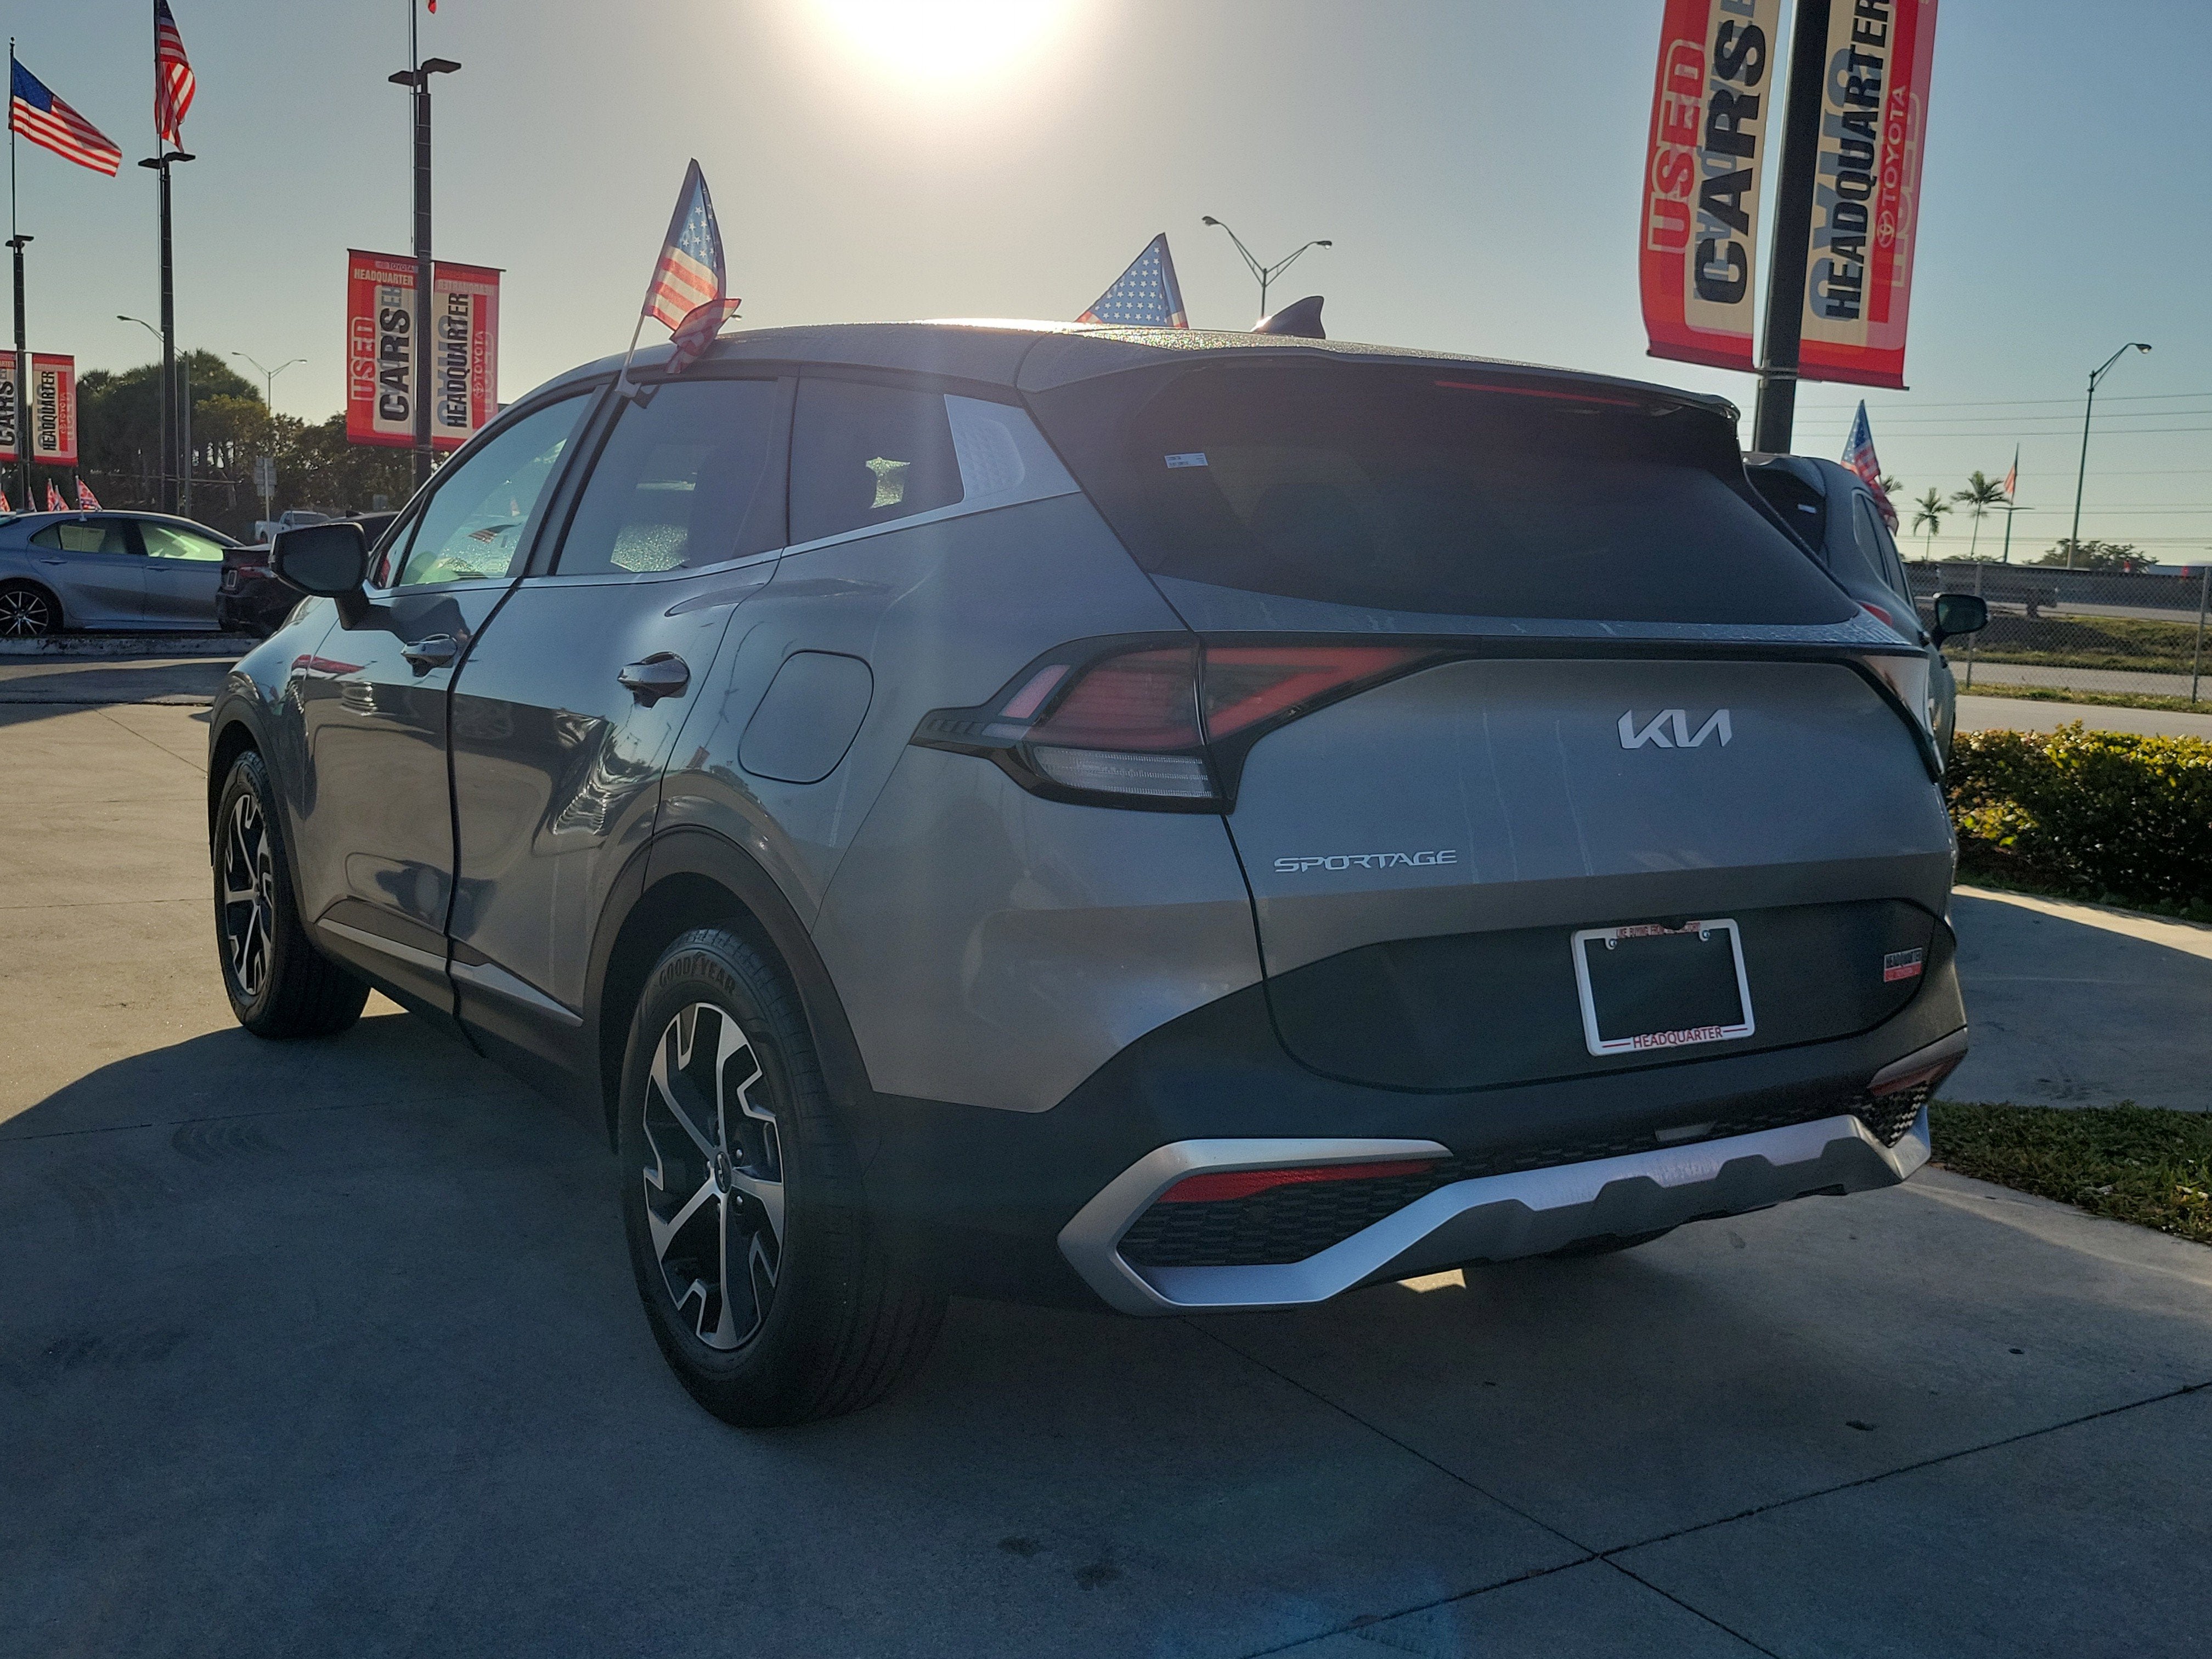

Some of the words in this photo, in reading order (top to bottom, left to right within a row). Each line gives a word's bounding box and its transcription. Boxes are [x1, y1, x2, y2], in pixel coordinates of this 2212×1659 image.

[1647, 38, 1705, 253] USED
[1694, 20, 1766, 304] CARS
[1825, 0, 1889, 319] HEADQUARTER
[1882, 86, 1908, 206] TOYOTA
[354, 268, 414, 286] HEADQUARTER
[351, 317, 376, 401] USED
[380, 308, 410, 421] CARS
[447, 292, 470, 427] HEADQUARTER
[473, 331, 484, 381] TOYOTA
[42, 371, 57, 450] HEADQUARTER
[1617, 709, 1732, 749] KIA
[1274, 850, 1458, 873] SPORTAGE
[659, 953, 736, 994] GOODYEAR
[1633, 1026, 1723, 1049] HEADQUARTER
